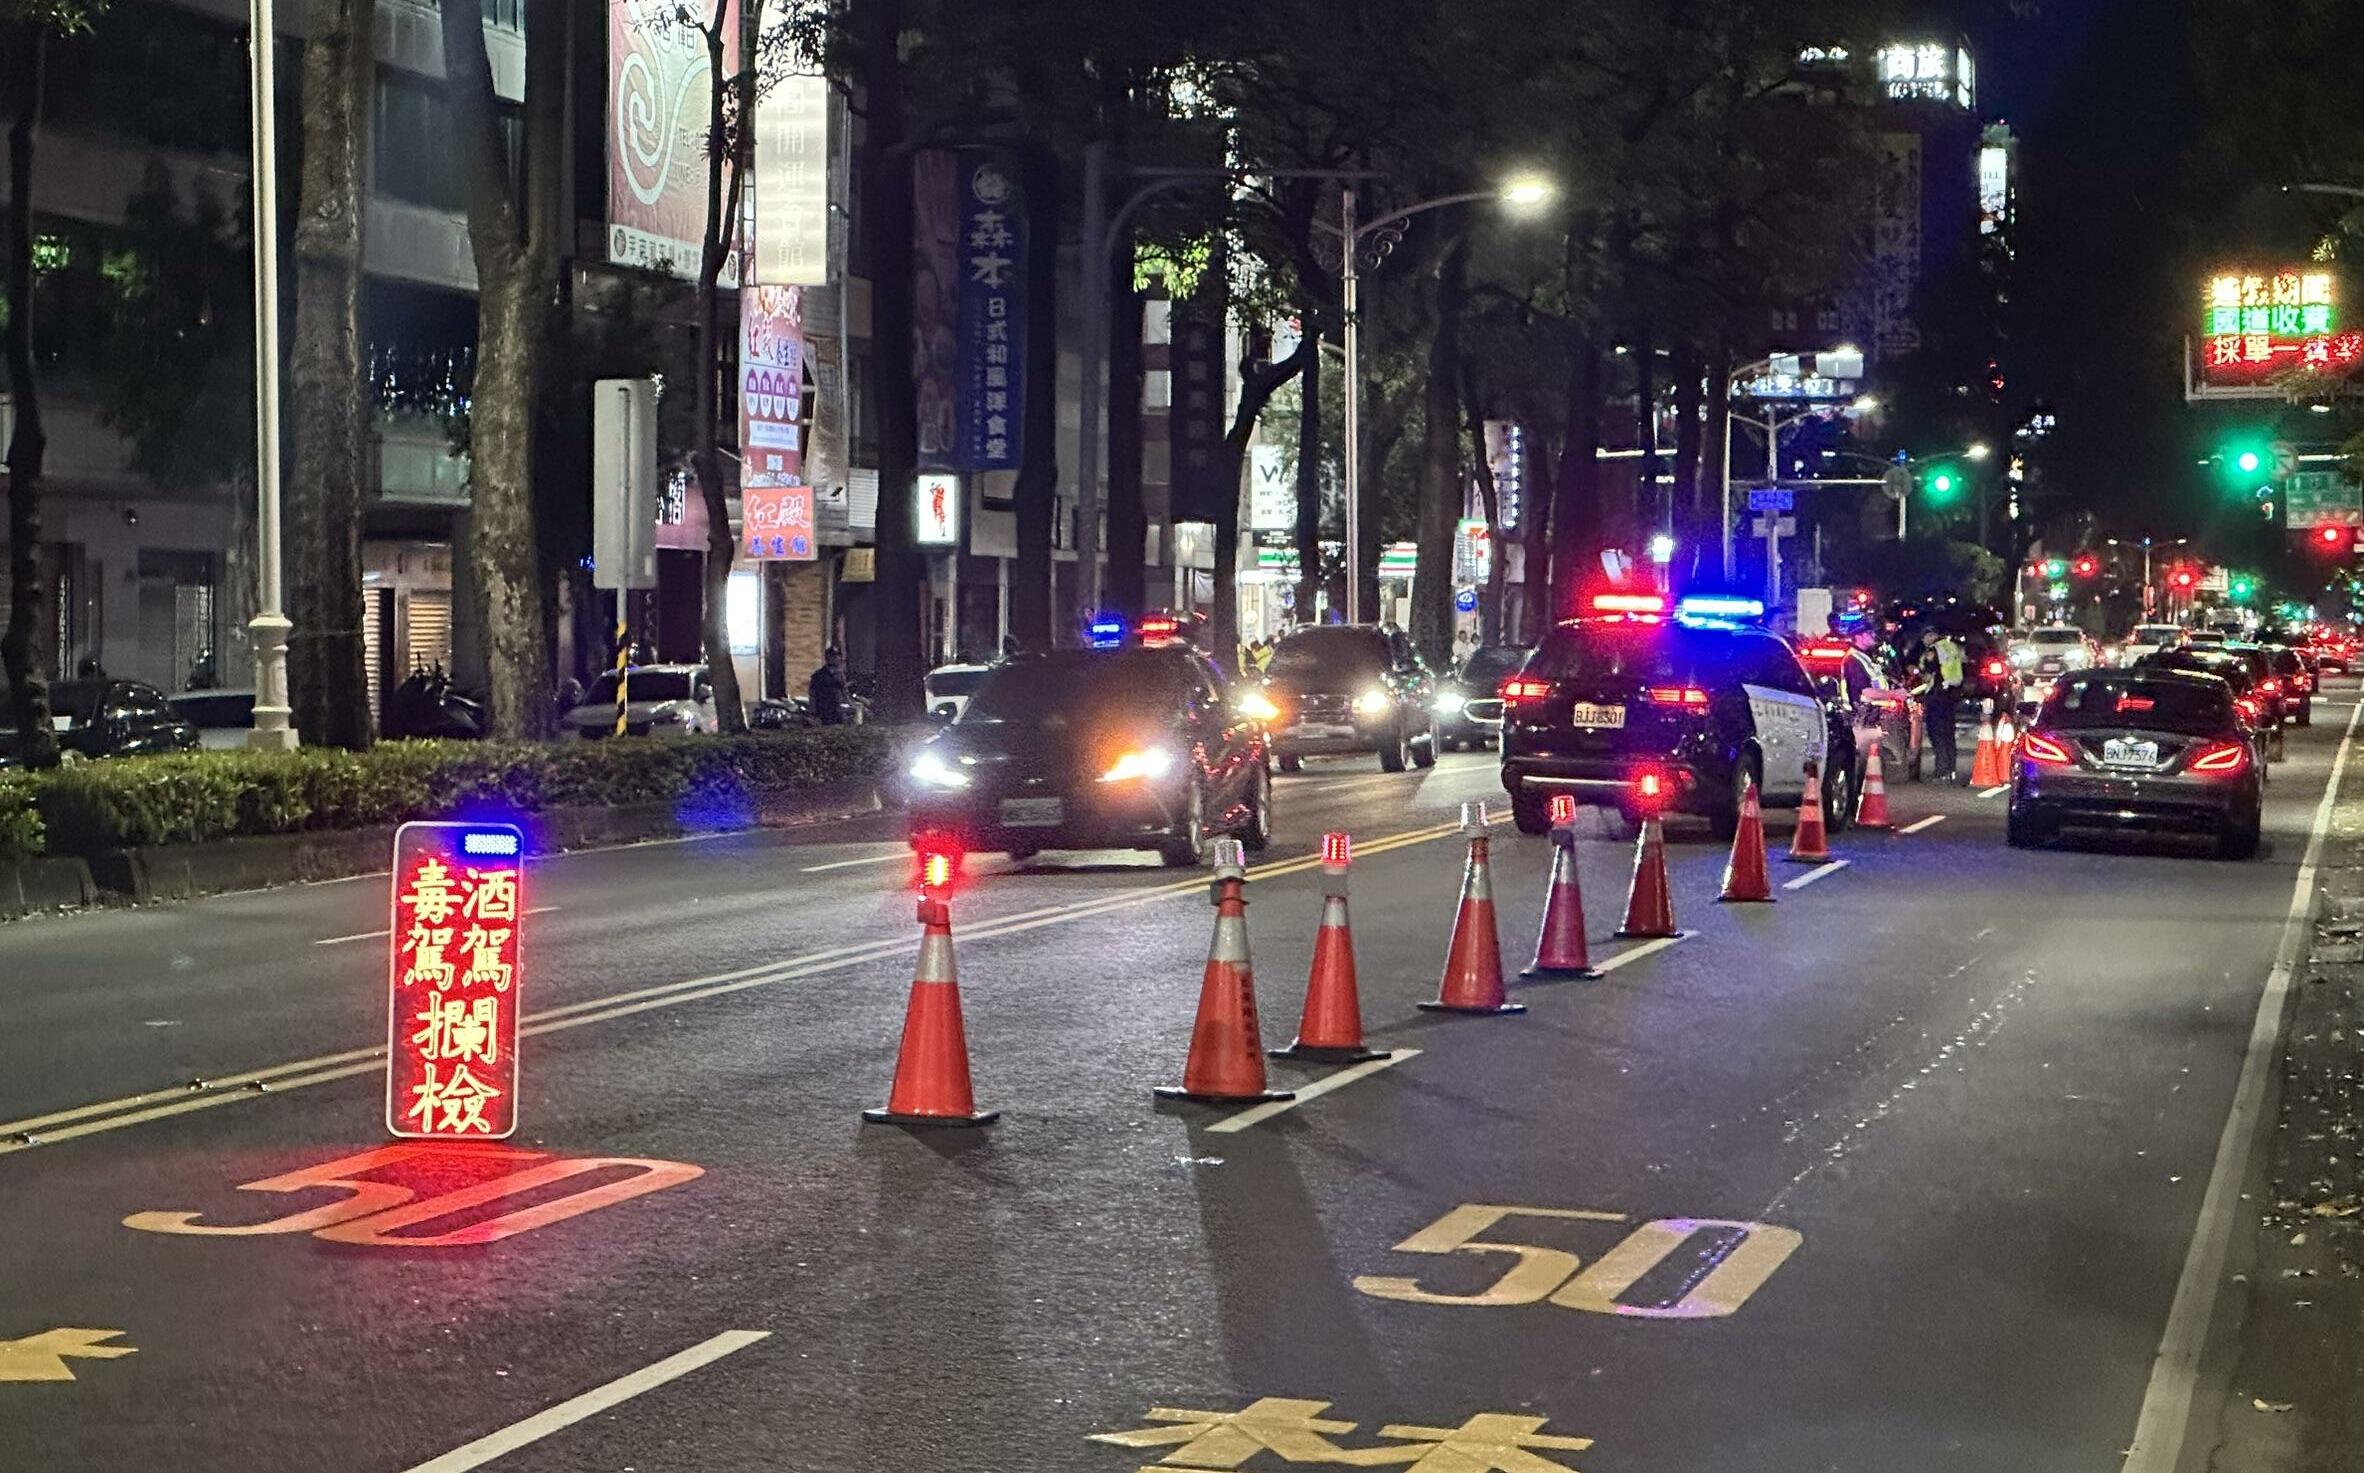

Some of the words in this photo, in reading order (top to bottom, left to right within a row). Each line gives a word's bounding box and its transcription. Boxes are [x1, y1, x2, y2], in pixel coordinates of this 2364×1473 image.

[1886, 44, 1946, 80] 商旅
[969, 209, 1012, 289] 森本
[2212, 304, 2331, 335] 國道收費
[401, 858, 463, 991] 毒駕
[461, 867, 517, 992] 酒駕
[122, 1143, 706, 1246] 50
[1352, 1204, 1804, 1318] 50
